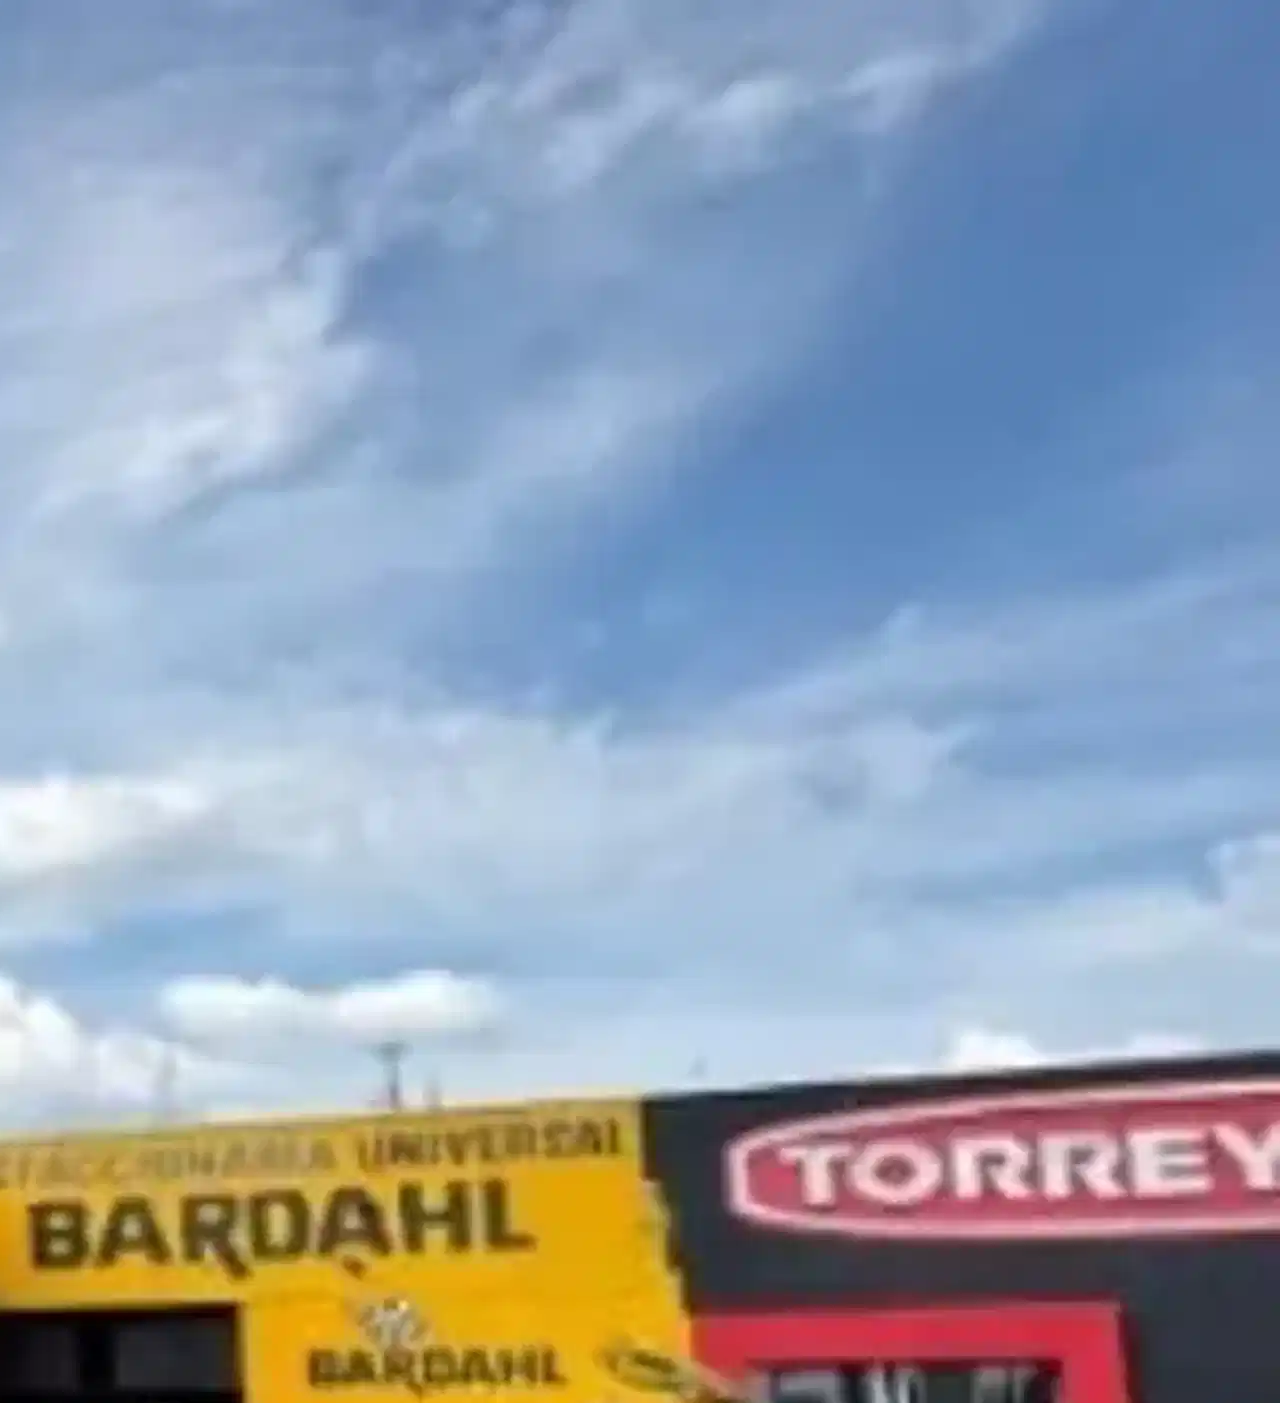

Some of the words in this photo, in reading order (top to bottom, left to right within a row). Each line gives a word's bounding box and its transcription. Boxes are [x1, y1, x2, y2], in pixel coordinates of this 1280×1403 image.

[777, 1121, 1280, 1206] TORREY
[26, 1178, 541, 1284] BARDAHL
[306, 1343, 571, 1402] BARDAHL
